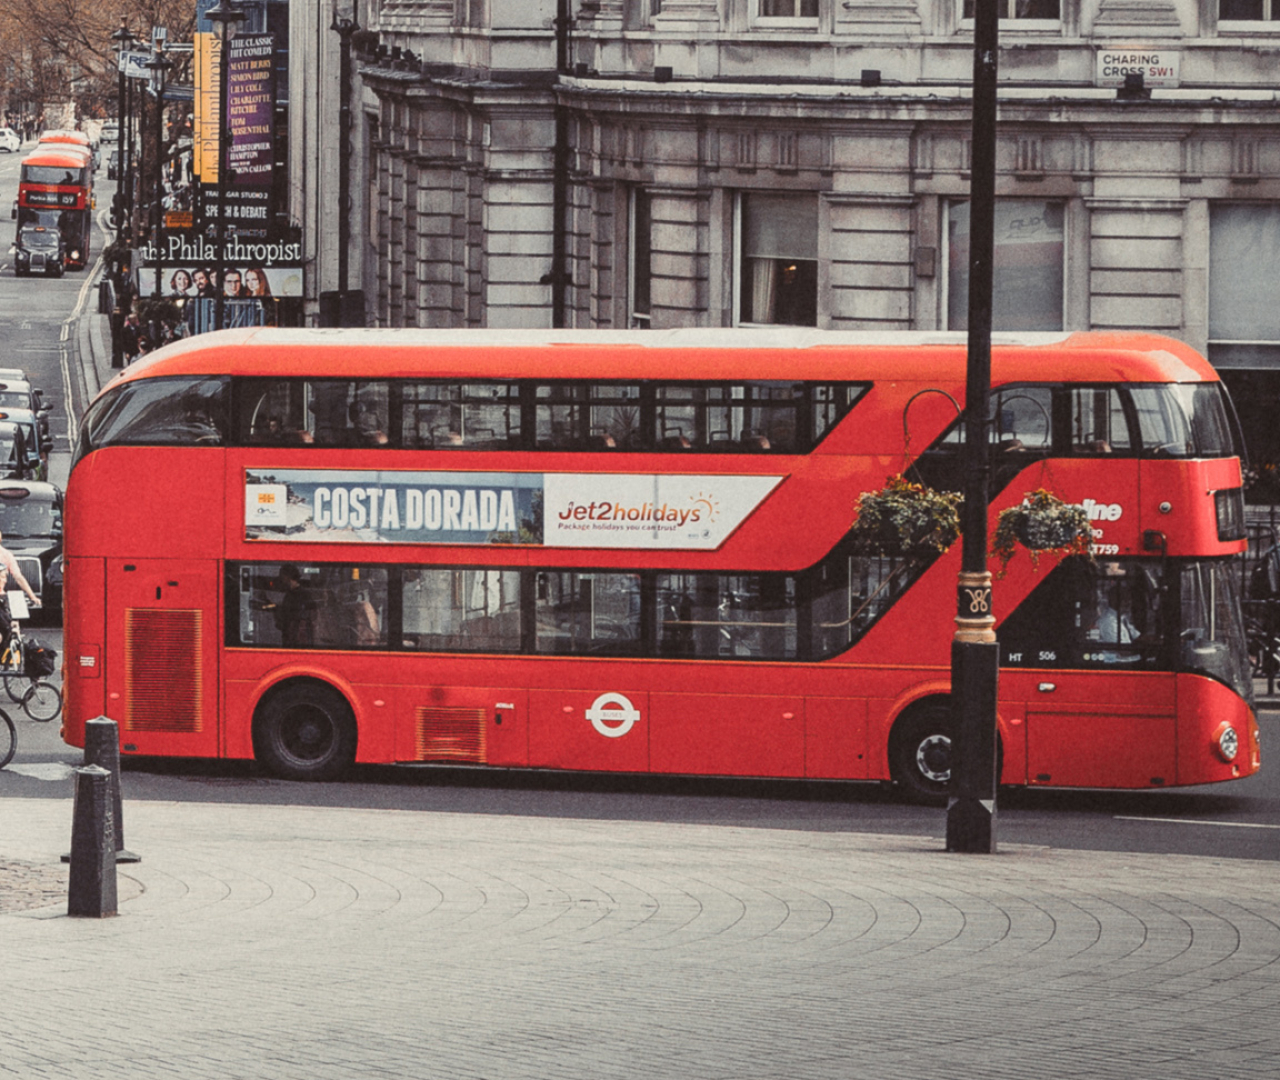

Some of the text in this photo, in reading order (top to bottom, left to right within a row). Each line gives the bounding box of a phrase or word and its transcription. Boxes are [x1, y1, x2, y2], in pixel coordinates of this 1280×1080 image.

[230, 37, 273, 48] THE CLASSIC
[230, 47, 272, 58] HIT COMEDY
[1103, 54, 1160, 65] CHARING
[1103, 66, 1173, 77] CROSS SW1
[230, 94, 271, 105] CHARLOTTE
[230, 142, 271, 152] CHRISTOPHER
[230, 151, 258, 160] HAMPTON
[205, 204, 267, 219] SPEH & DEBATE
[313, 486, 517, 531] COSTA DORADA
[558, 522, 590, 531] Package
[592, 523, 624, 531] holidays
[1009, 653, 1023, 661] HT
